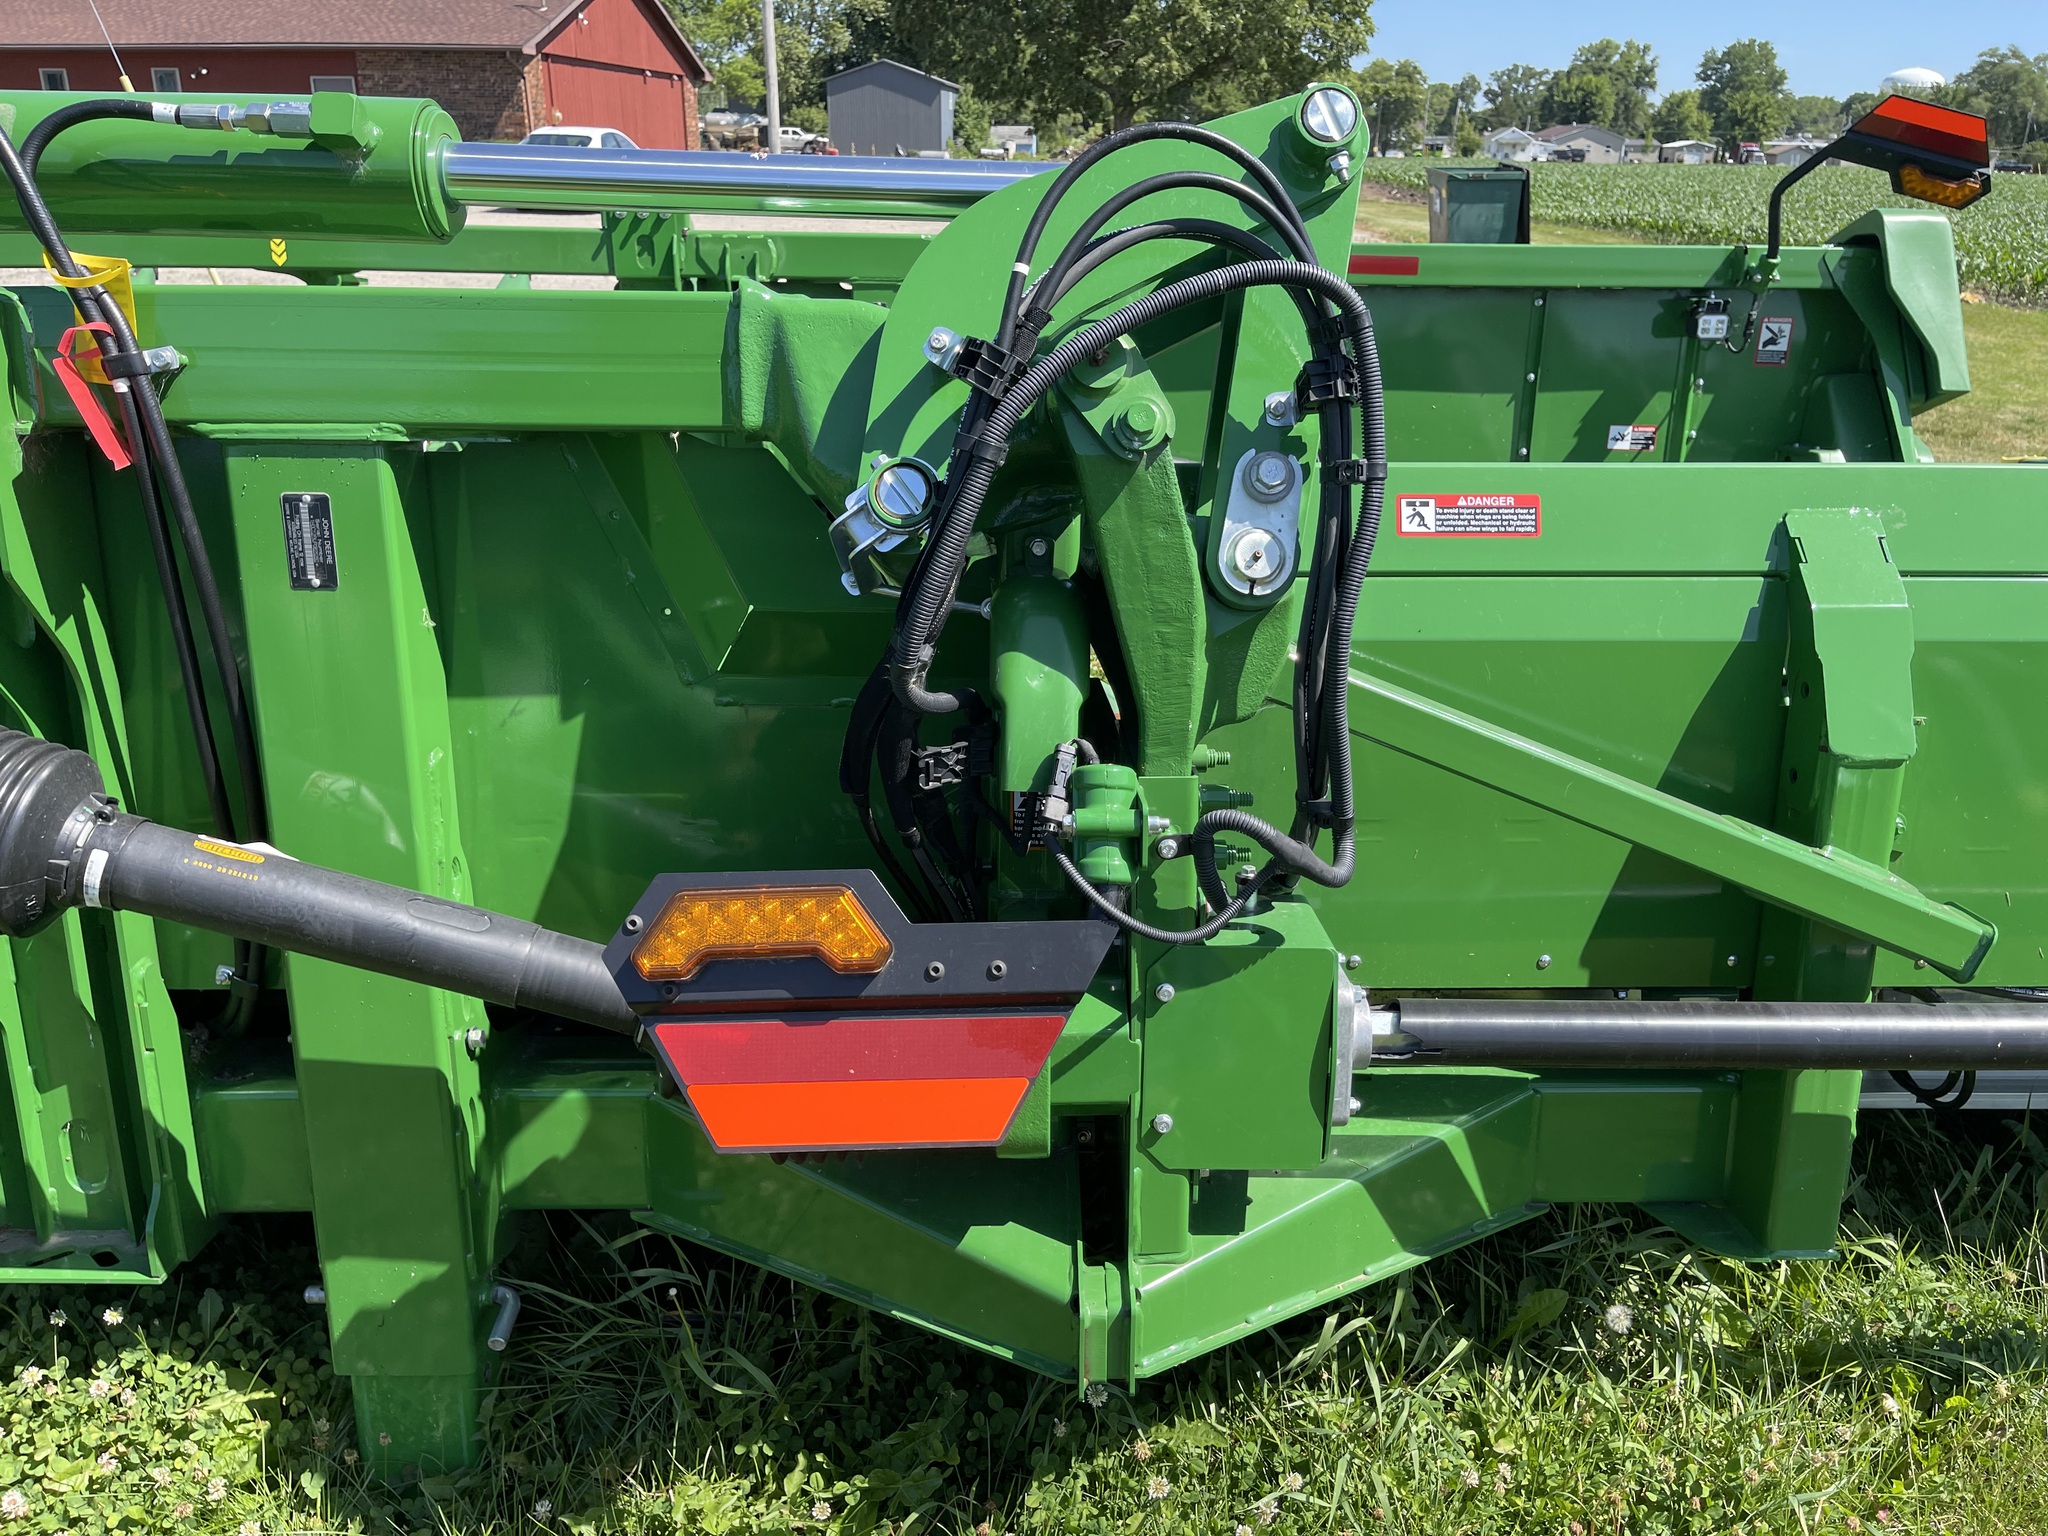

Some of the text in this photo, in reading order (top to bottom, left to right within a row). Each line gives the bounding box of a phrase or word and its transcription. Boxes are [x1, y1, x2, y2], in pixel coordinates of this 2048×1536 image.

[1467, 496, 1515, 506] DANGER
[321, 517, 332, 564] JOHN DEERE
